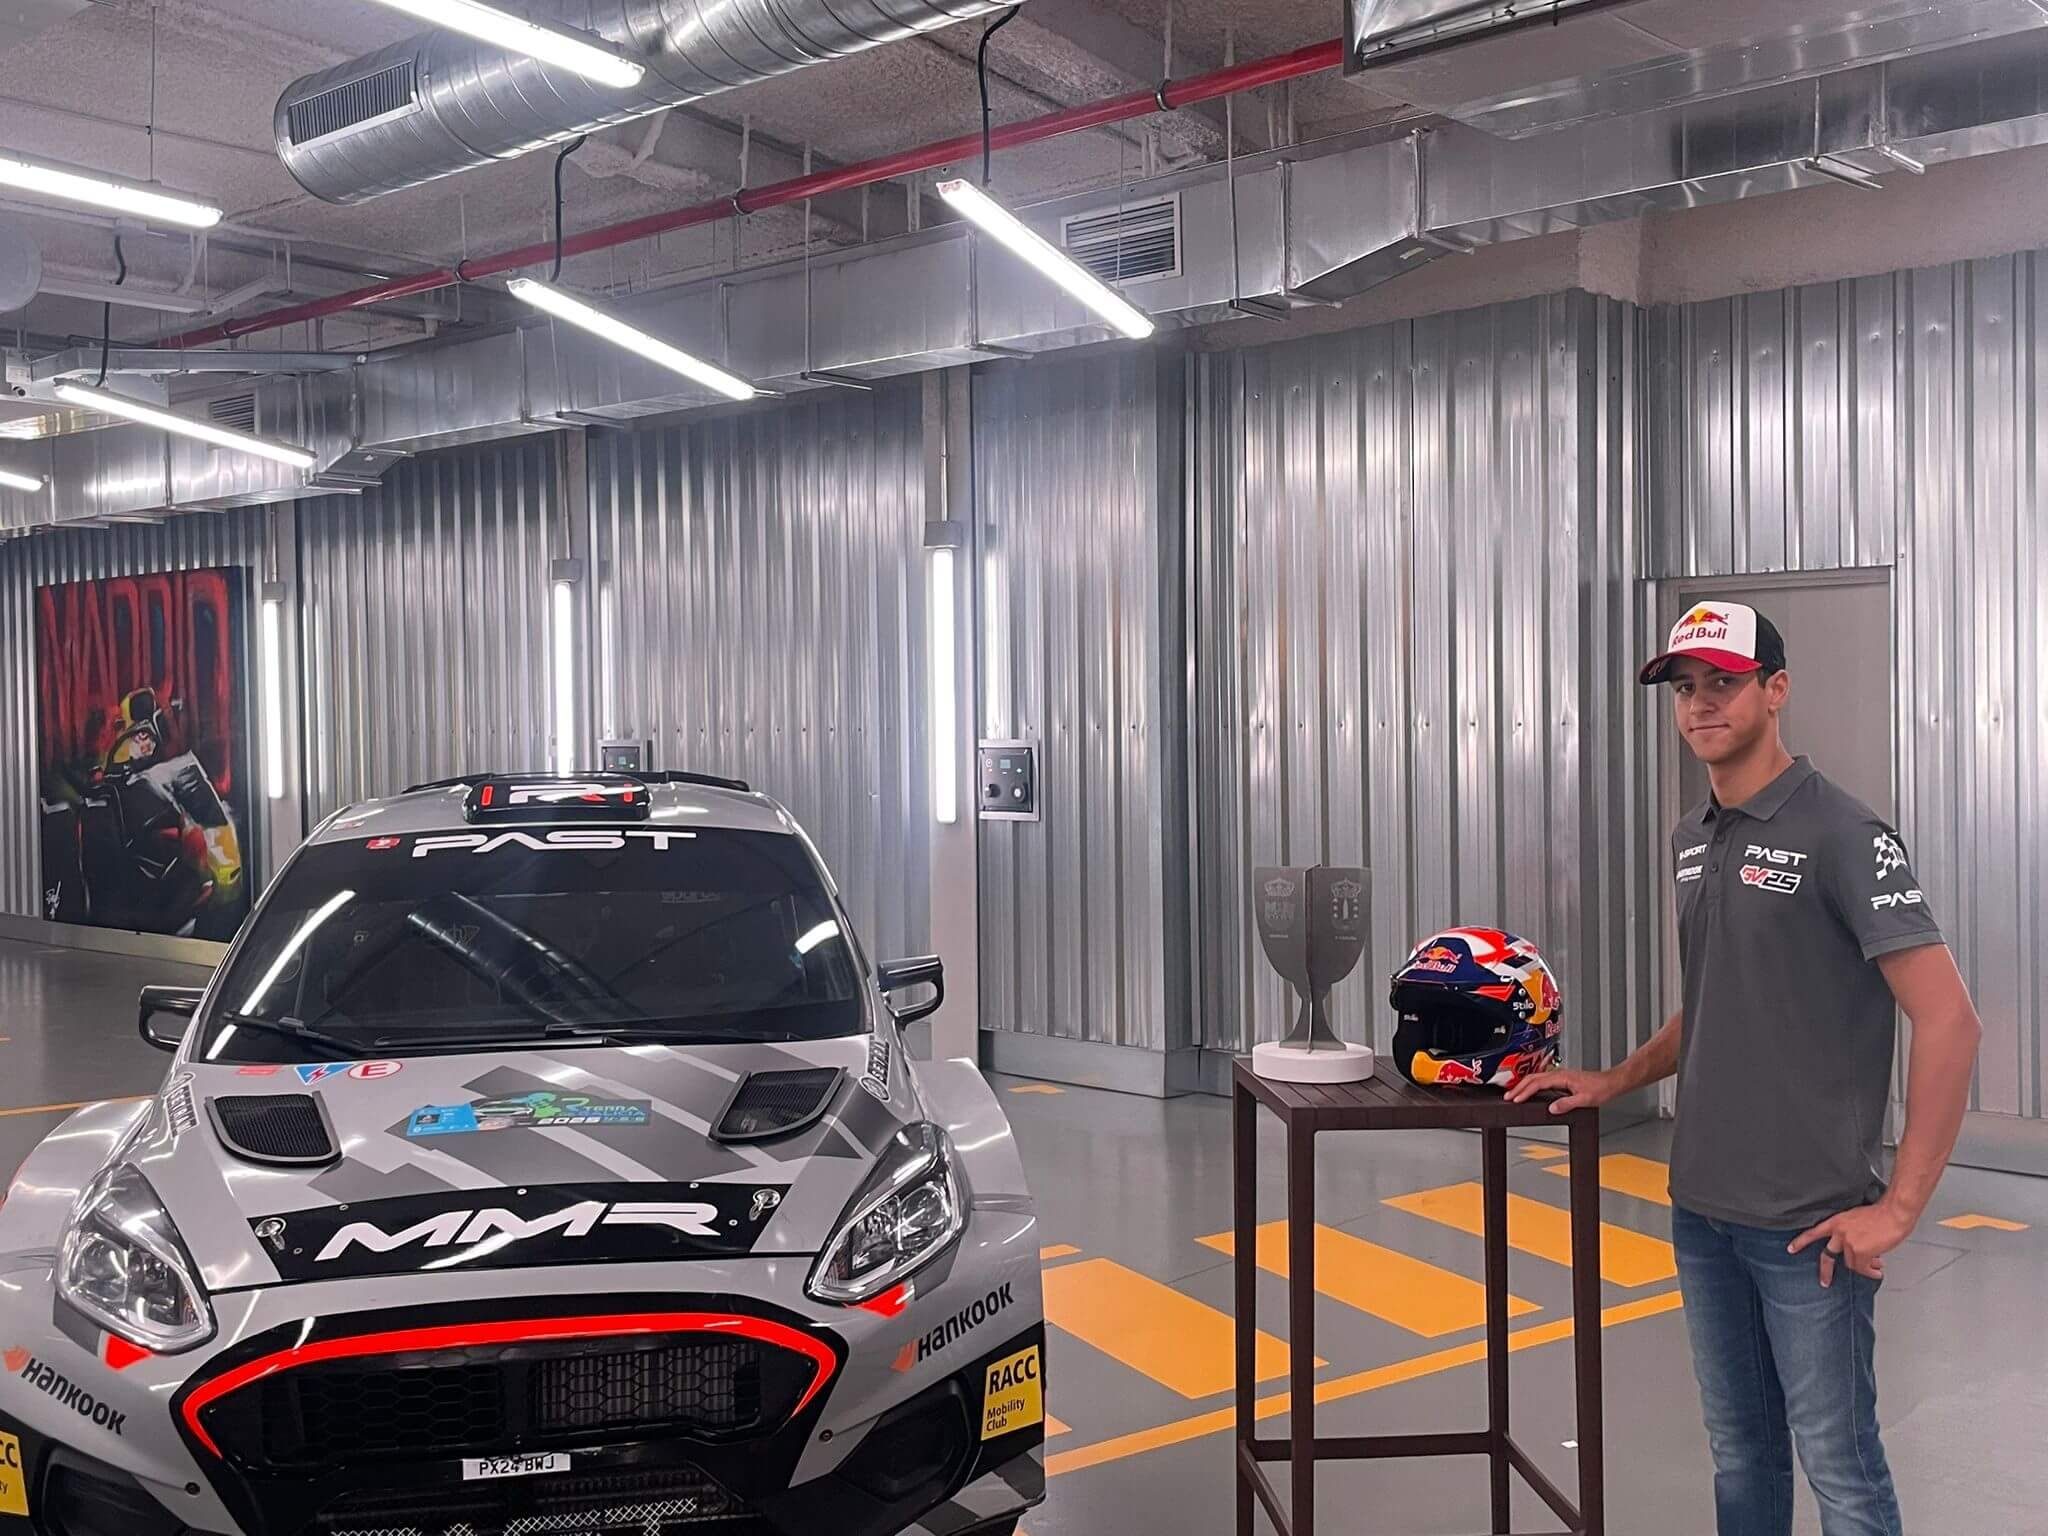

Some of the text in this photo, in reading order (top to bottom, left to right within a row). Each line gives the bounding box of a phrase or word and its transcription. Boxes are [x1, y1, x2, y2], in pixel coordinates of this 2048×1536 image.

[1696, 627, 1727, 640] Bull
[411, 830, 697, 858] PAST
[1744, 844, 1808, 867] PAST
[1870, 889, 1923, 910] PAS
[1513, 999, 1534, 1011] Stilo
[361, 1063, 388, 1077] E
[315, 1202, 721, 1262] MMR
[988, 1354, 1037, 1395] RACC
[986, 1398, 1026, 1420] Mobility
[986, 1416, 1008, 1432] Club
[524, 1455, 555, 1472] BWJ
